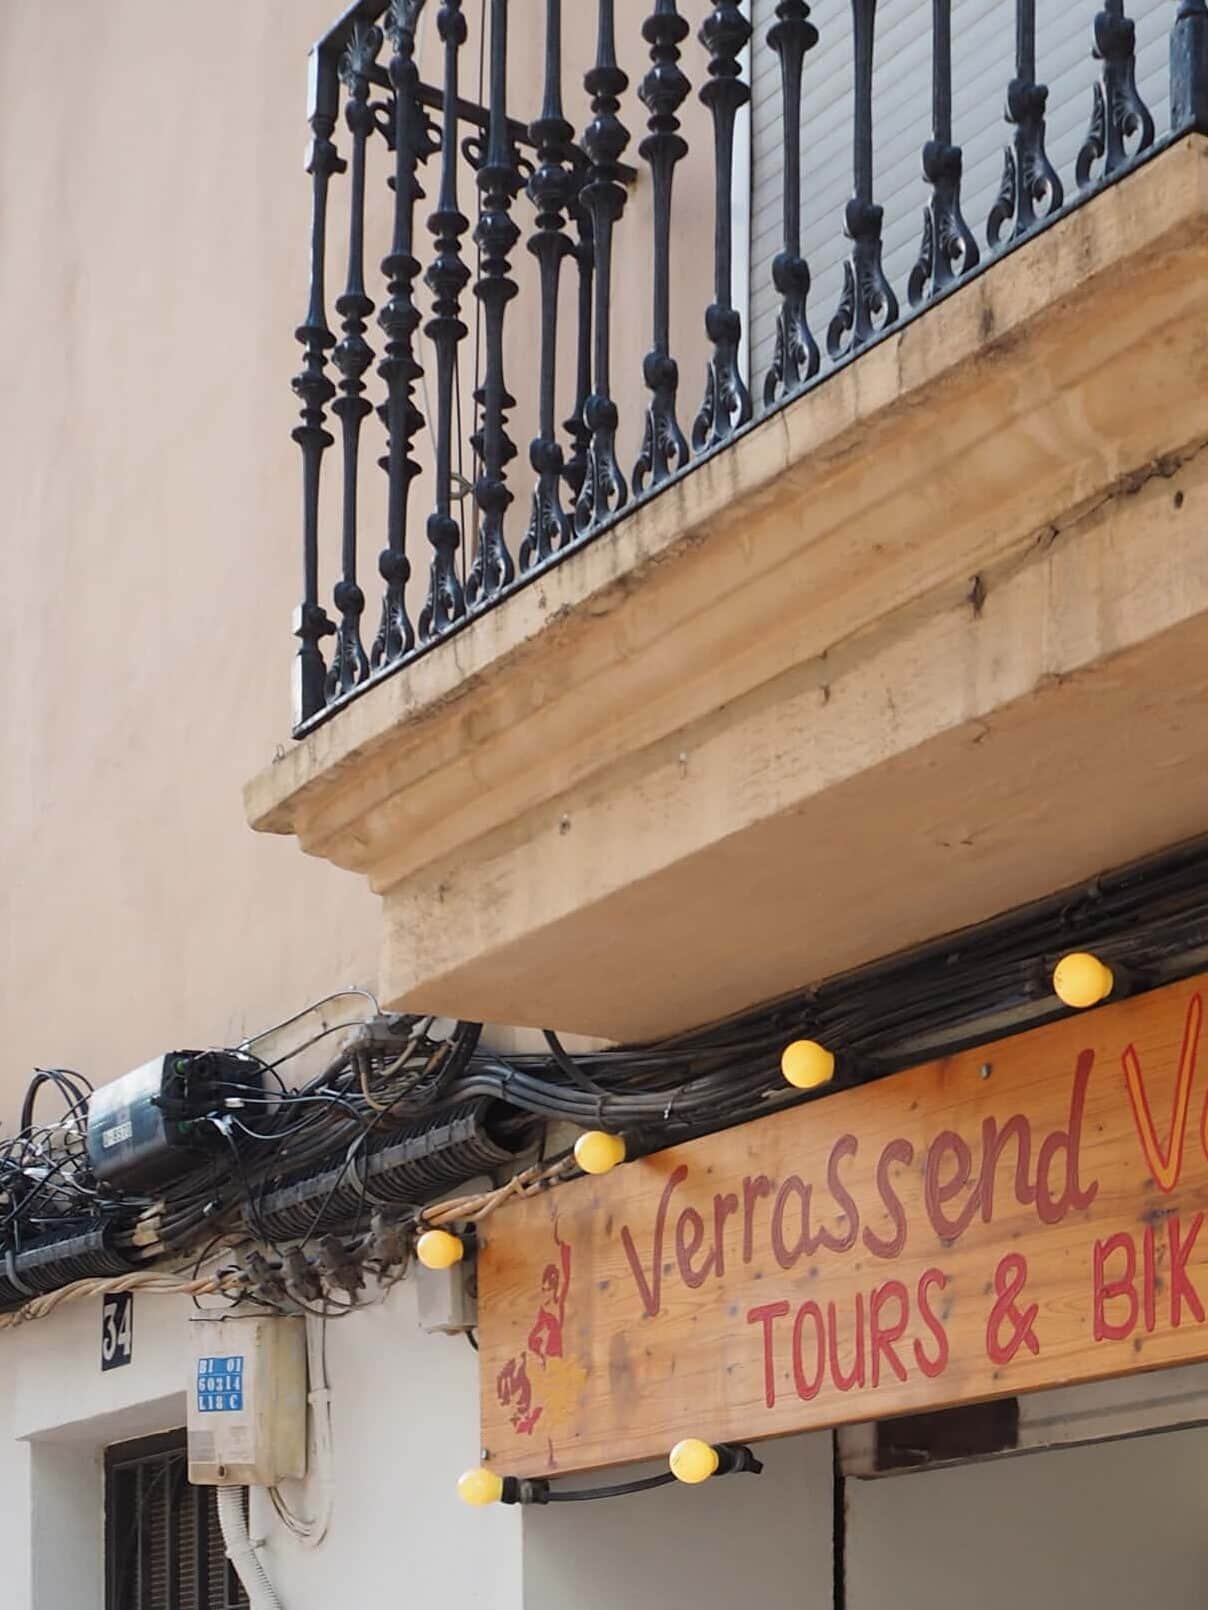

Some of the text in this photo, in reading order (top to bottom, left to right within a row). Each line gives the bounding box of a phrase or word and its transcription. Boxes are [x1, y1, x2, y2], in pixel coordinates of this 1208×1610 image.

[103, 1298, 131, 1361] 34
[747, 1267, 949, 1409] TOURS
[985, 1252, 1040, 1366] &
